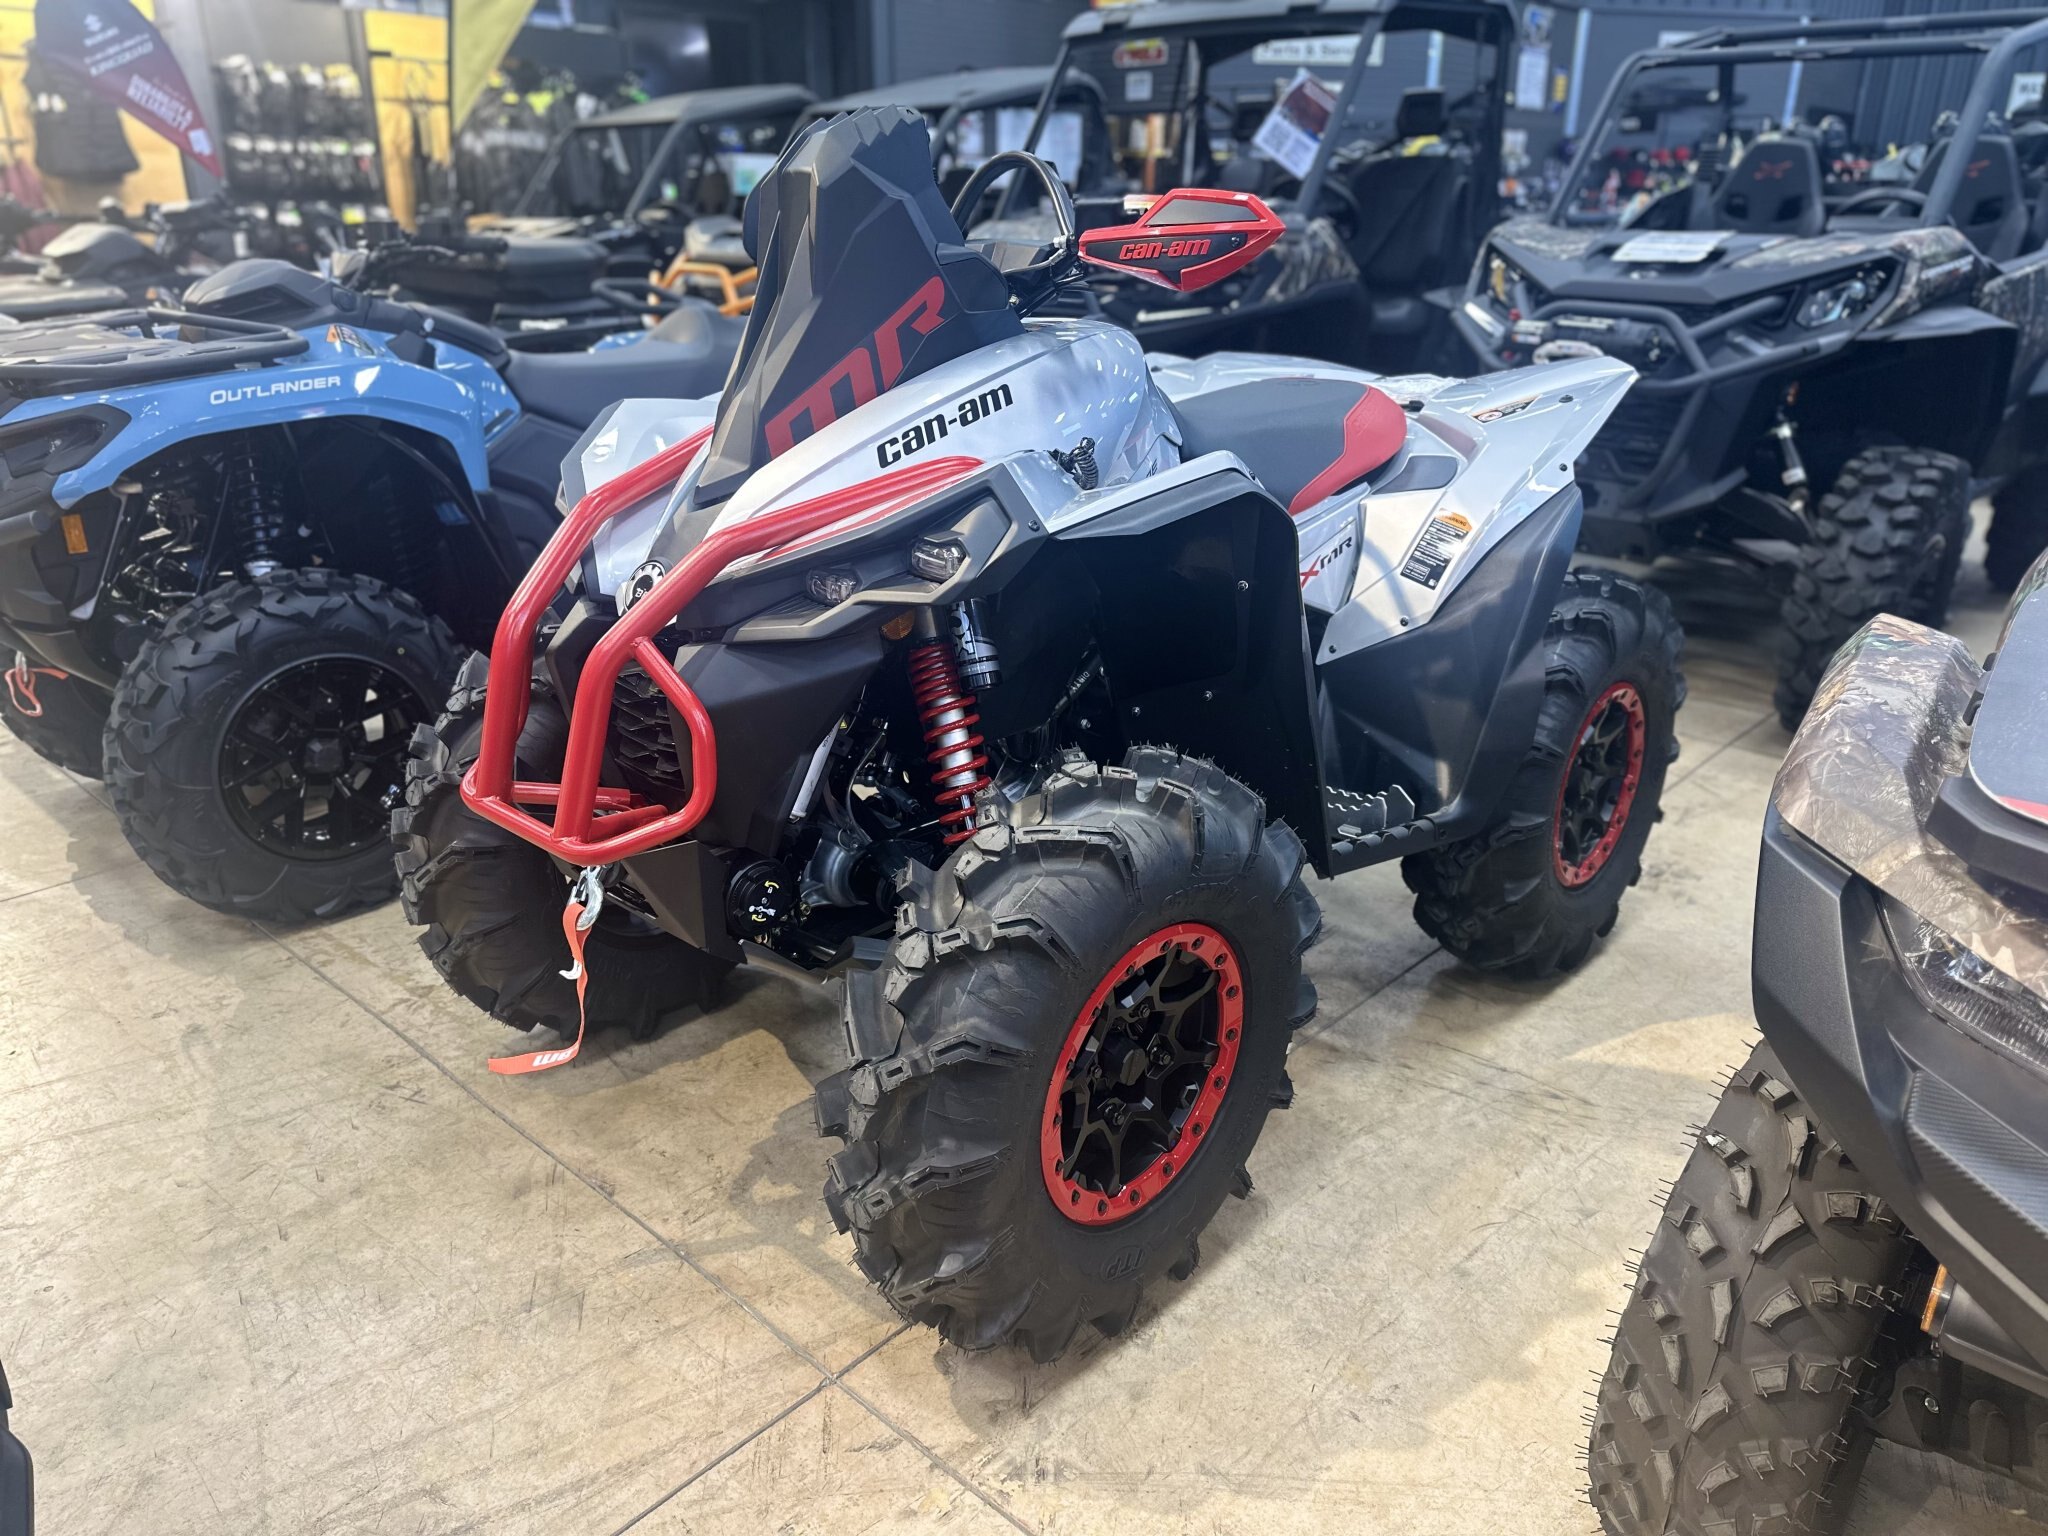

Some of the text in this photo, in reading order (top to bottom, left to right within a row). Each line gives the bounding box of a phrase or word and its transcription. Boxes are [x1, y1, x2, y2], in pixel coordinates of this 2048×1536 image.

[1119, 239, 1212, 261] can-am
[209, 375, 342, 405] OUTLANDER
[876, 383, 1014, 470] can-am
